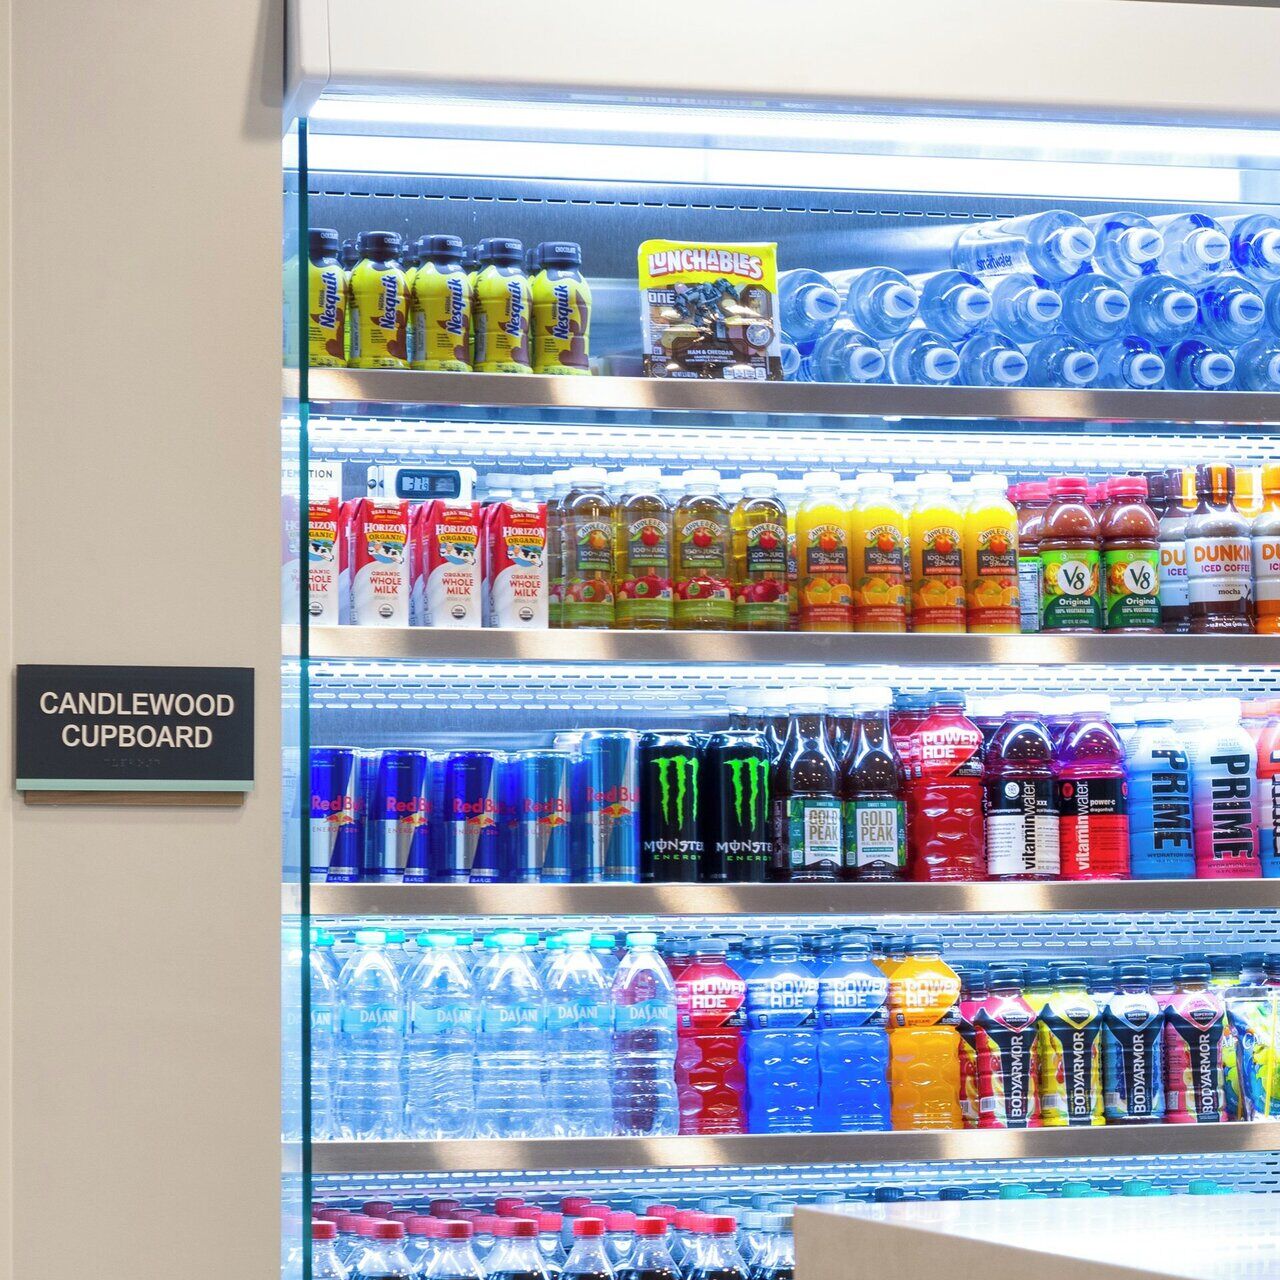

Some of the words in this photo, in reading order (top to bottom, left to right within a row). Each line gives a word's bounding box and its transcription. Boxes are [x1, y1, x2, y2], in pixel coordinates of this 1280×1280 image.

[648, 248, 764, 281] LUNCHABLES
[318, 271, 339, 329] Nesquik
[377, 274, 398, 330] Nesquik
[445, 278, 464, 335] Nesquik
[503, 281, 522, 338] Nesquik
[551, 284, 570, 340] Nesquik
[364, 522, 408, 535] HORIZON
[436, 524, 478, 537] HORIZON
[502, 526, 545, 538] HORIZON
[369, 533, 404, 543] ORGANIC
[440, 535, 476, 544] ORGANIC
[507, 537, 544, 545] ORGANIC
[1201, 564, 1221, 573] ICED
[369, 578, 402, 586] WHOLE
[441, 579, 475, 588] WHOLE
[509, 581, 541, 590] WHOLE
[1062, 566, 1085, 590] V8
[1129, 565, 1151, 590] V8
[374, 586, 399, 594] MILK
[446, 588, 471, 596] MILK
[514, 589, 538, 598] MILK
[1218, 587, 1241, 596] mocha
[1059, 598, 1091, 608] Original
[1126, 597, 1156, 607] Original
[39, 691, 236, 717] CANDLEWOOD
[61, 724, 214, 749] CUPBOARD
[922, 731, 978, 746] POWER
[922, 745, 957, 759] ADE
[311, 795, 342, 811] Red
[386, 797, 417, 812] Red
[452, 798, 483, 814] Red
[524, 798, 554, 813] Red
[1151, 749, 1192, 850] PRIME
[1210, 753, 1254, 860] PRIME
[808, 809, 838, 826] GOLD
[860, 810, 893, 826] GOLD
[1021, 781, 1036, 870] vitaminwater
[1075, 780, 1090, 871] vitaminwater
[808, 825, 839, 841] PEAK
[860, 826, 894, 842] PEAK
[557, 998, 598, 1020] DASANI
[691, 995, 728, 1009] ADE
[770, 994, 804, 1008] ADE
[834, 994, 867, 1008] ADE
[359, 1003, 399, 1024] DASANI
[436, 1003, 472, 1024] DASANI
[500, 1002, 538, 1023] DASANI
[629, 1000, 669, 1021] DASANI
[1010, 1035, 1024, 1118] BODYARMOR
[1072, 1031, 1086, 1115] BODYARMOR
[1133, 1033, 1146, 1114] BODYARMOR
[1200, 1033, 1214, 1116] BODYARMOR
